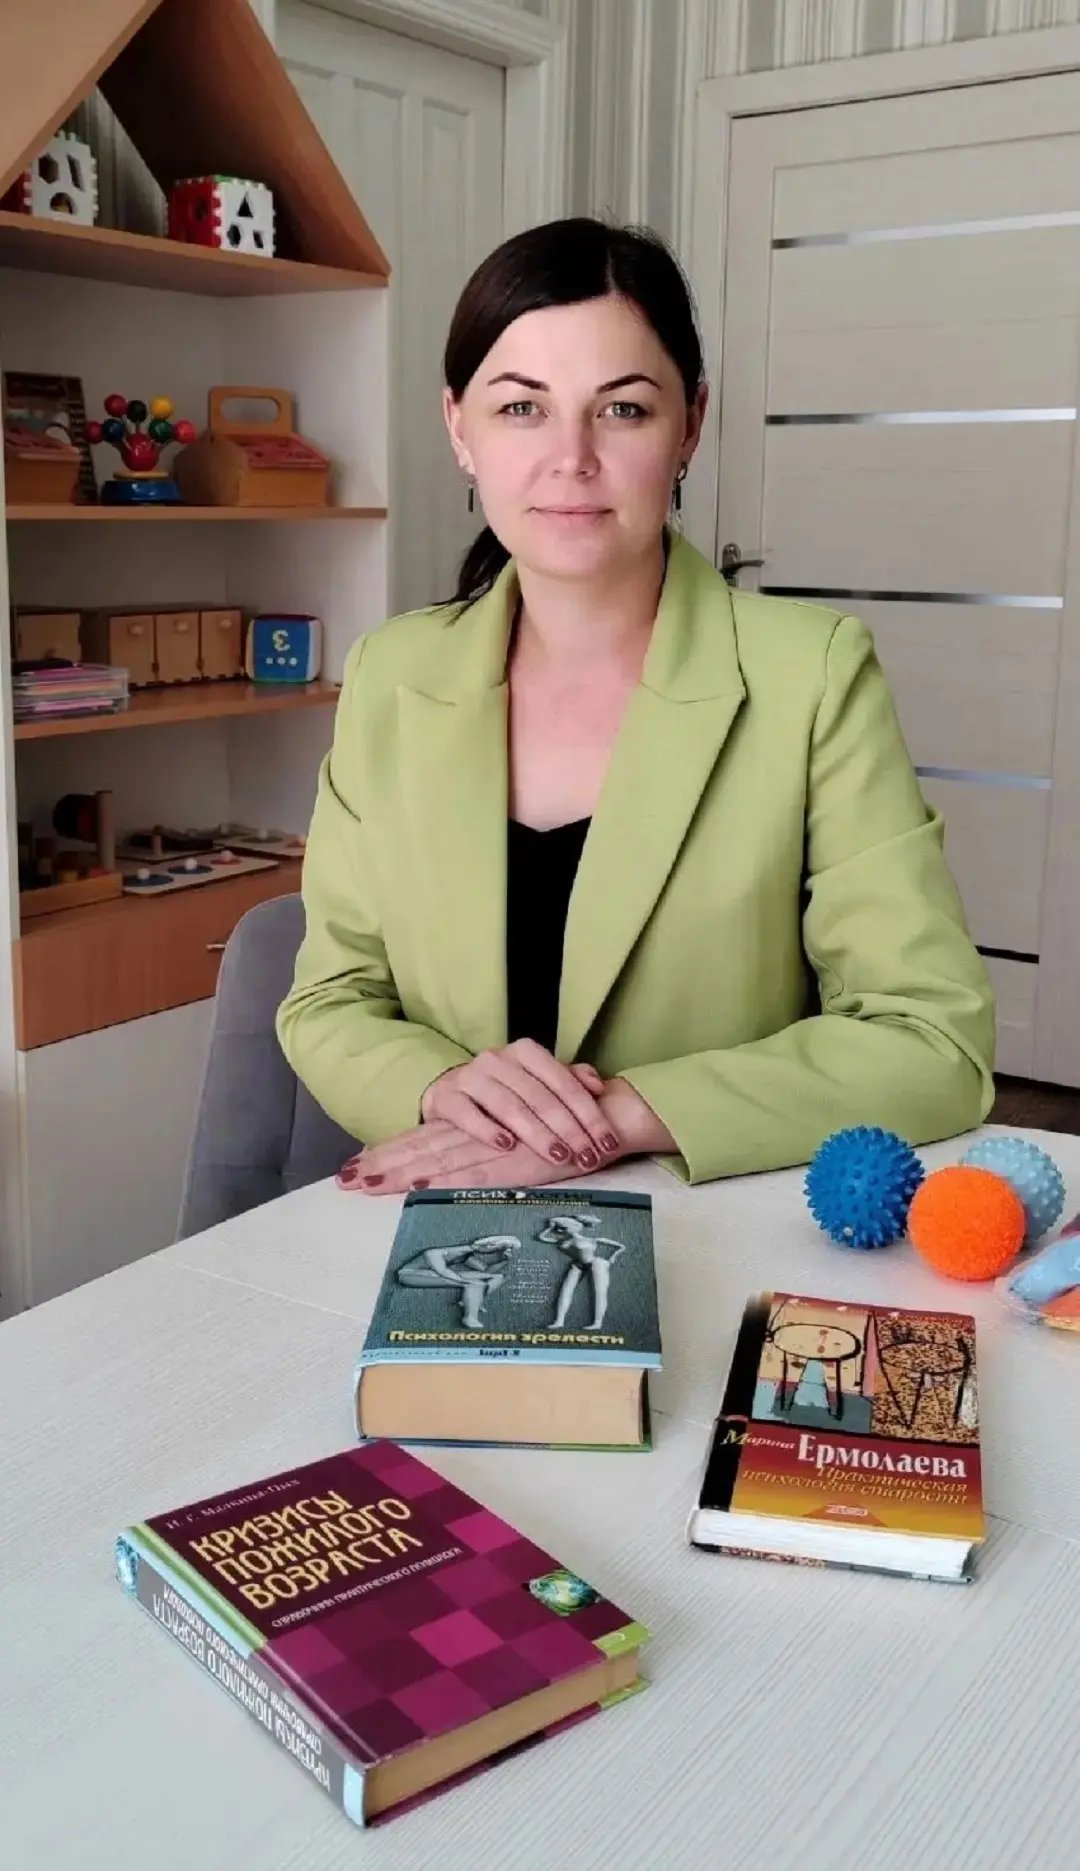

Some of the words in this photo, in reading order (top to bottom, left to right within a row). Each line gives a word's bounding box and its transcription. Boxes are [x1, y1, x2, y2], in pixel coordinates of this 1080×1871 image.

[388, 1330, 516, 1342] Психология
[521, 1333, 624, 1345] зрелости
[721, 1430, 795, 1449] Марина
[797, 1433, 967, 1479] Ермолаева
[742, 1470, 856, 1492] психология
[860, 1486, 968, 1504] старости
[817, 1468, 968, 1493] Практическая
[188, 1490, 354, 1561] КРИЗИСЫ
[212, 1498, 412, 1586] ПОЖИЛОГО
[237, 1527, 424, 1610] ВОЗРАСТА
[152, 1593, 205, 1664] ВОЗРАСТА
[207, 1649, 273, 1731] ПОЖИЛОГО
[275, 1715, 331, 1793] КРИЗИСЫ
